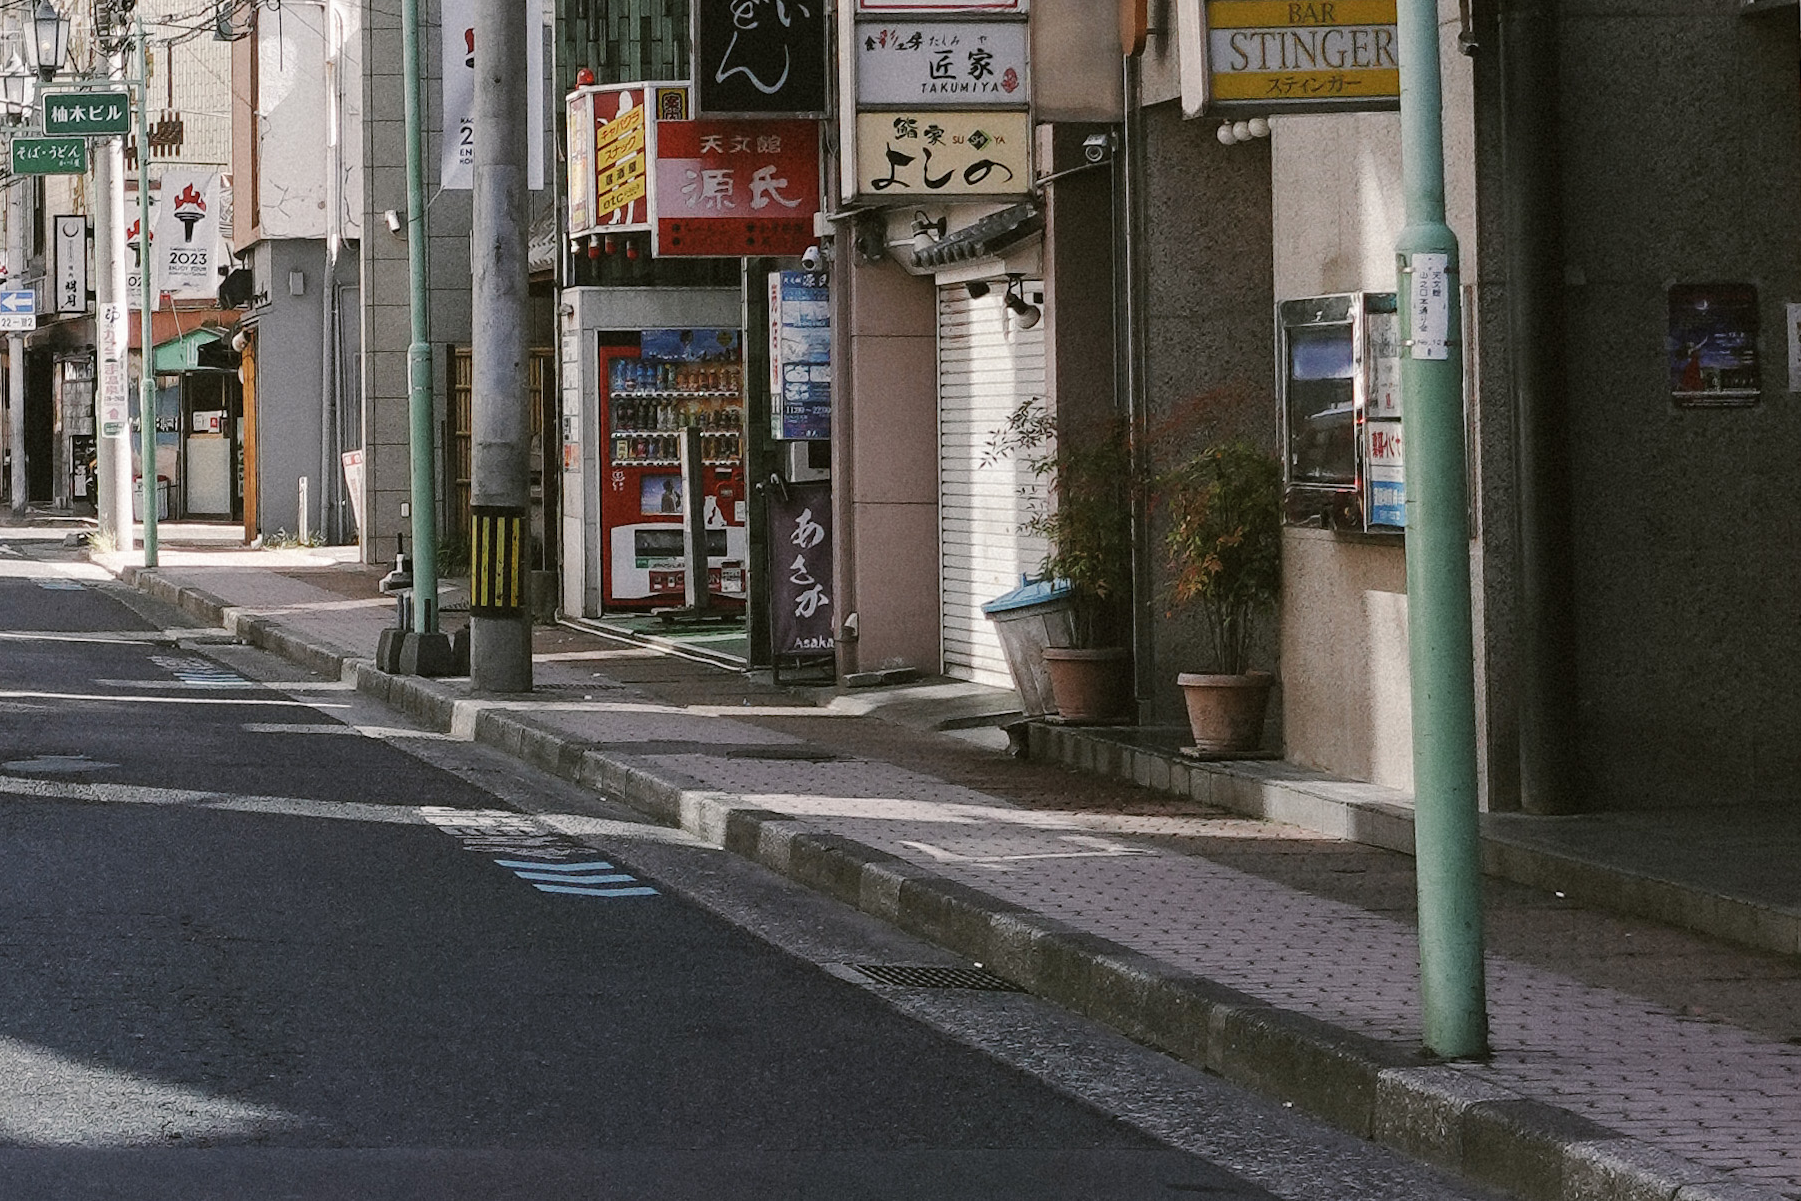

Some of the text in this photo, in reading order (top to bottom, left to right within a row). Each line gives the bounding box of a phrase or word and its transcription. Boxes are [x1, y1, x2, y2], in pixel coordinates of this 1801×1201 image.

[1287, 2, 1336, 24] BAR
[1229, 28, 1396, 72] STINGER
[929, 47, 995, 81] 匠家
[921, 81, 1000, 93] TAKUMIYA
[1266, 76, 1362, 94] スティンガー
[50, 106, 123, 125] 柚木ビル
[605, 135, 637, 162] スナック
[700, 134, 782, 154] 天文館
[952, 135, 965, 145] SU
[993, 135, 1006, 145] YA
[16, 145, 81, 160] そば・うどん
[871, 141, 1013, 191] よしの
[680, 165, 803, 211] 源氏
[169, 252, 208, 265] 2023
[788, 507, 830, 618] あさか
